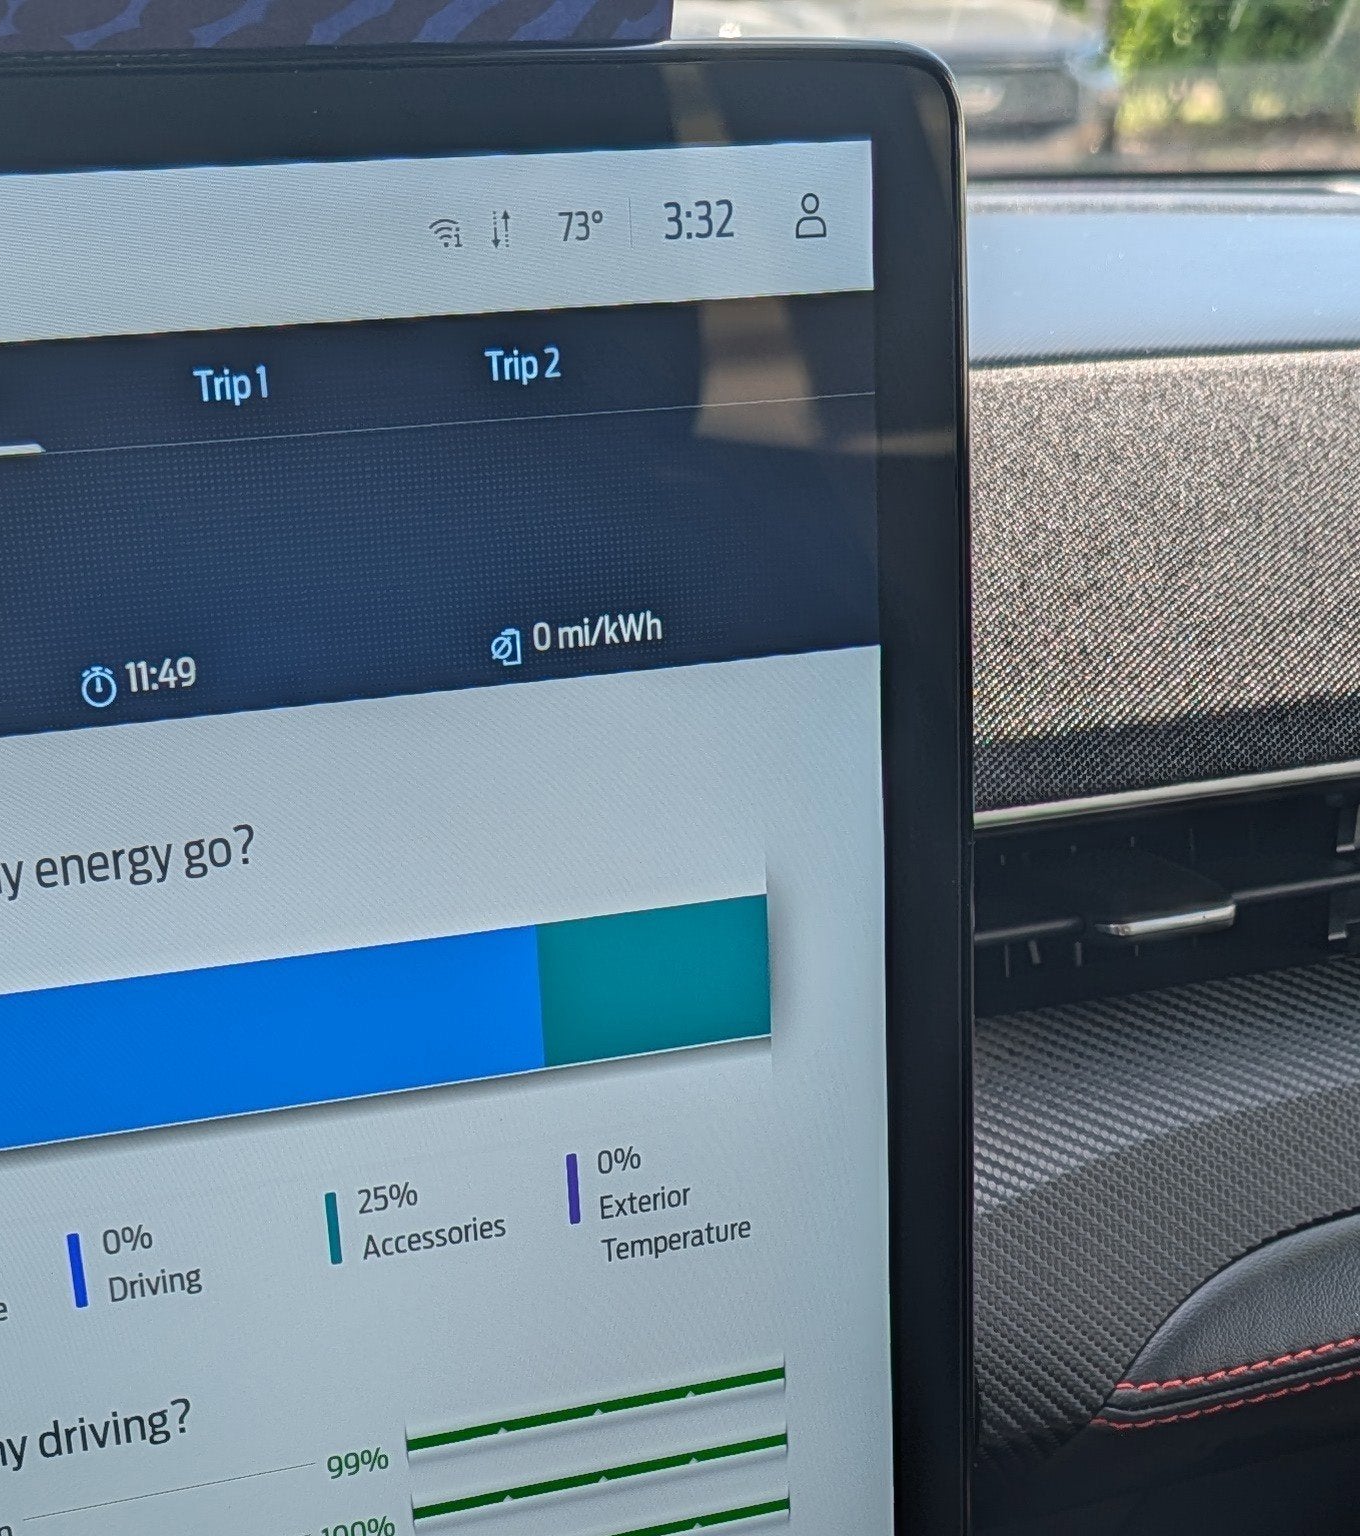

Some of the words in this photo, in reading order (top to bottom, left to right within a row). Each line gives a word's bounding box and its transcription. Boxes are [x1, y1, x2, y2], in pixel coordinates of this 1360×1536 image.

[664, 199, 733, 240] 3:32
[484, 350, 538, 385] Trip
[545, 347, 560, 378] 2
[194, 369, 251, 405] Trip
[257, 366, 268, 397] 1
[534, 622, 550, 650] 0
[557, 611, 662, 648] mi/kWh
[126, 657, 195, 691] 11:49
[36, 844, 172, 888] energy
[184, 824, 254, 878] go?
[598, 1147, 641, 1174] 0%
[358, 1183, 418, 1214] 25%
[600, 1188, 690, 1219] Exterior
[103, 1225, 153, 1255] 0%
[362, 1217, 507, 1260] Accessories
[602, 1217, 752, 1262] Temperature
[109, 1269, 202, 1302] Driving
[39, 1399, 190, 1458] driving?
[327, 1448, 389, 1479] 99%
